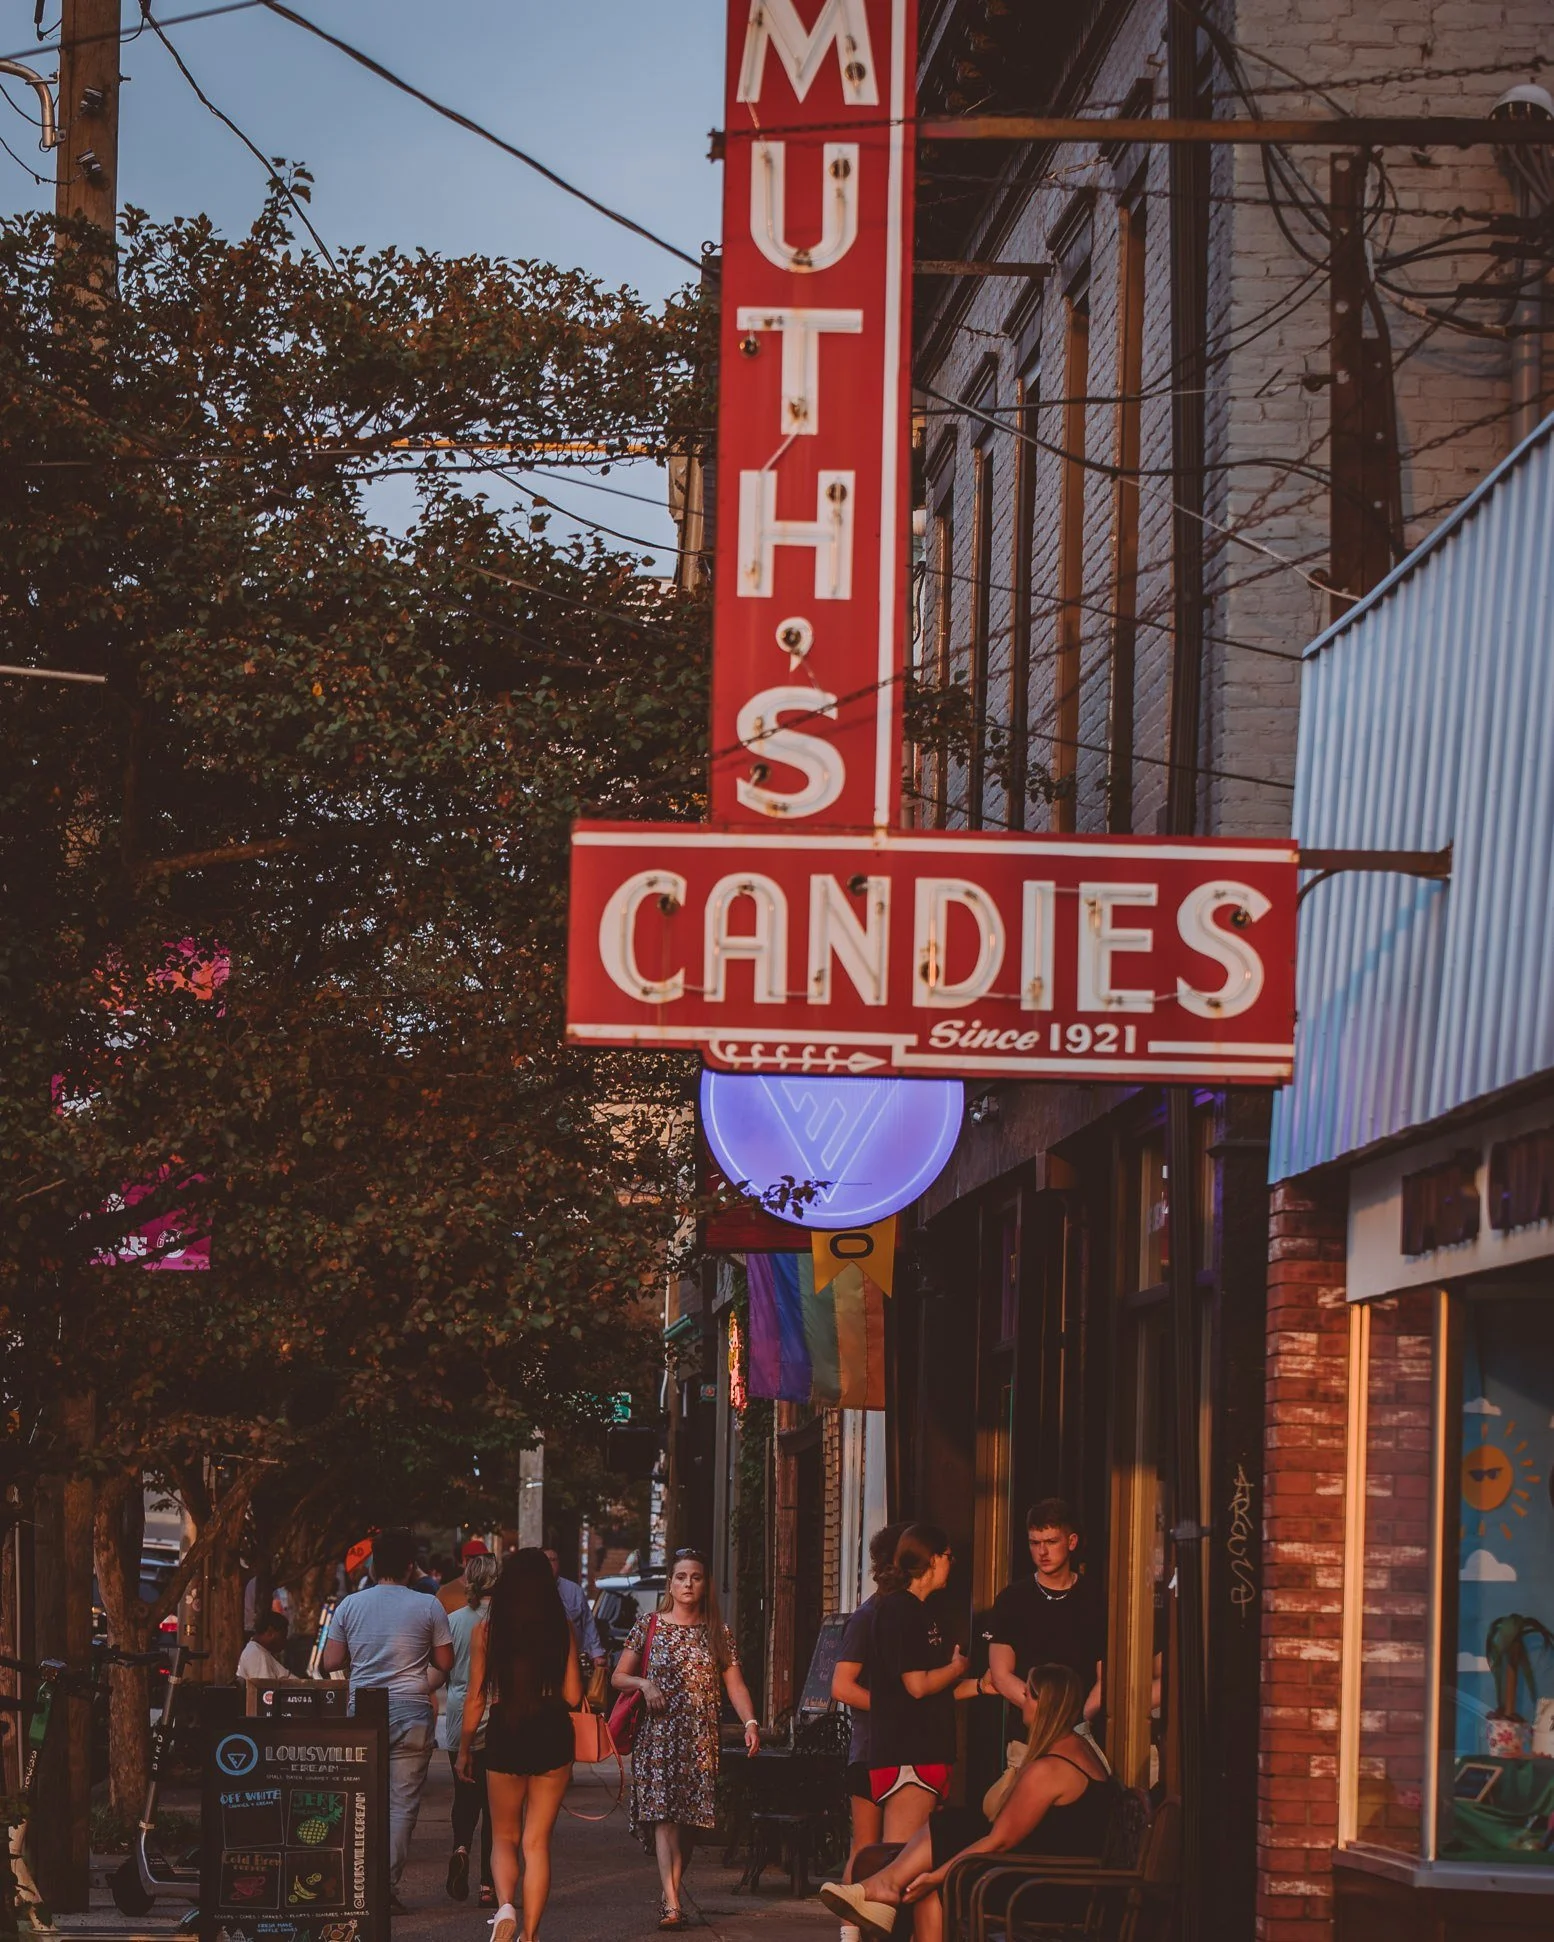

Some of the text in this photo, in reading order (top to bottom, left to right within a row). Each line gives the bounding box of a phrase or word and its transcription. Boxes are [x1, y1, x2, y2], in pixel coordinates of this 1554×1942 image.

[736, 0, 879, 818] MUTH'S
[599, 869, 1273, 1018] CANDIES
[928, 1018, 1136, 1054] Since 1921
[152, 1734, 163, 1771] BIRD
[265, 1745, 368, 1763] LOUISVILLE
[220, 1789, 281, 1804] OFF WHITE
[353, 1792, 366, 1909] @LOUISVILLECREAM
